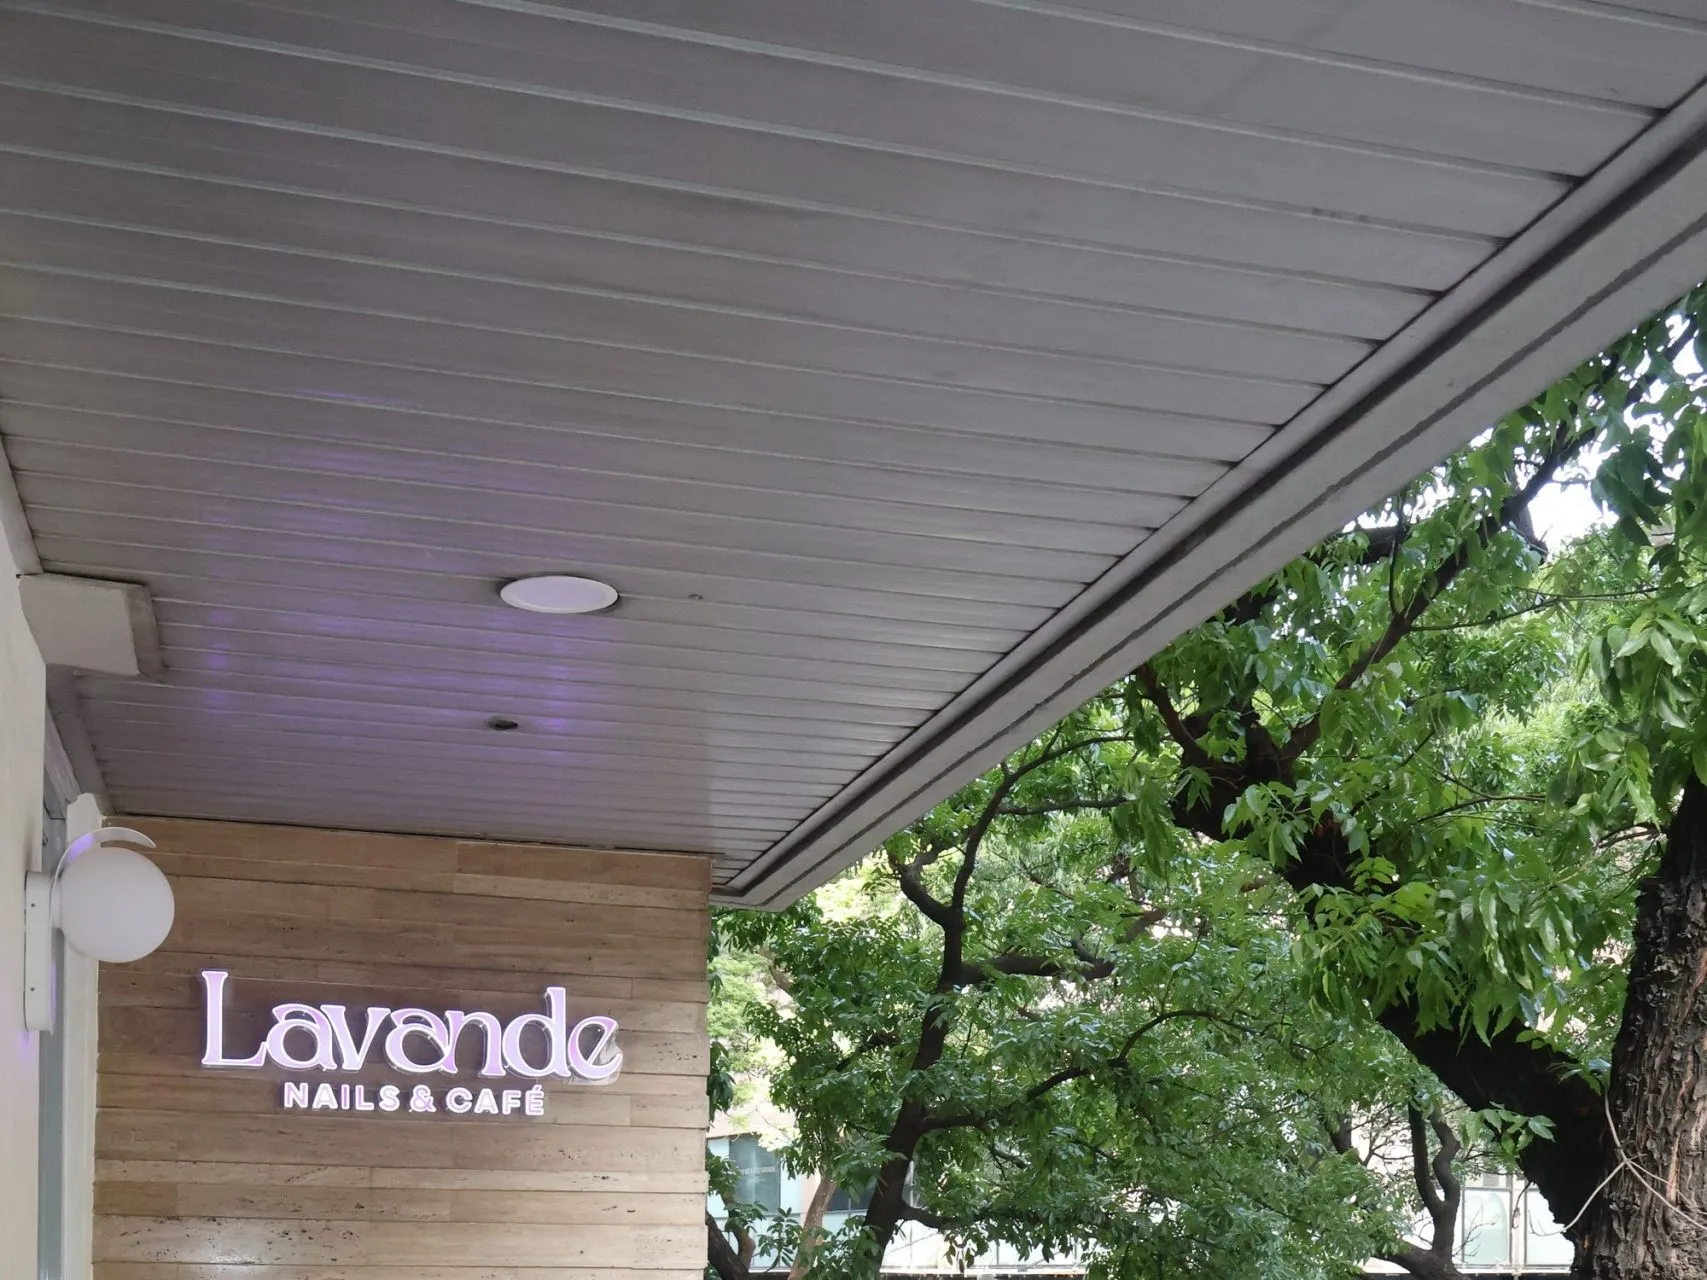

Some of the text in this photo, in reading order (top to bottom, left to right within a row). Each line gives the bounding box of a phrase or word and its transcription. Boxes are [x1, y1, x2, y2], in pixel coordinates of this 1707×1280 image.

[201, 970, 623, 1081] Lavande
[284, 1081, 544, 1116] NAILS & CAFÉ
